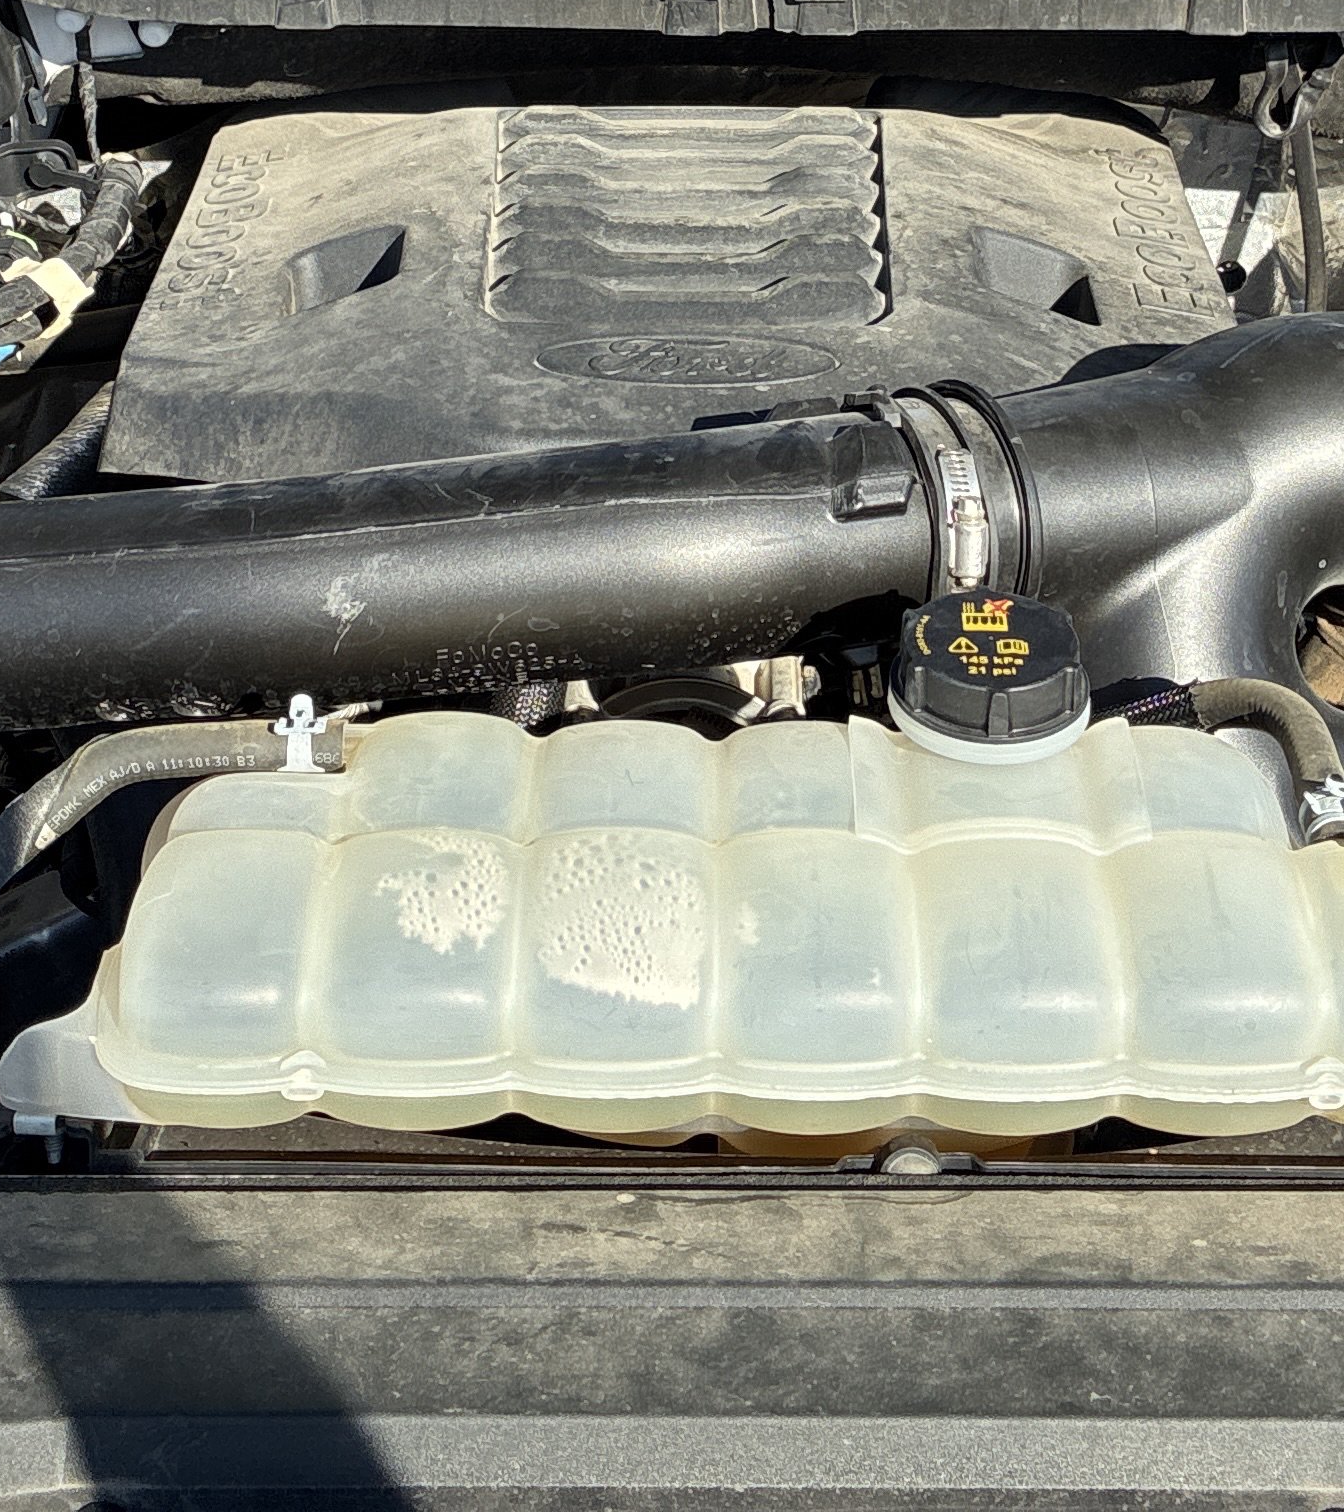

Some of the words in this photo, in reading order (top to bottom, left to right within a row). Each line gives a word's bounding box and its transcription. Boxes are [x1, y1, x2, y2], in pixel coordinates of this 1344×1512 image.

[588, 338, 786, 376] Ford
[437, 641, 537, 666] FoMoCo
[959, 656, 989, 664] 145
[993, 655, 1024, 665] kPa
[967, 666, 987, 675] 21
[992, 666, 1017, 676] psi
[84, 775, 108, 798] MEX
[146, 760, 156, 772] A
[162, 755, 230, 771] 11:10:30
[237, 754, 256, 767] B3
